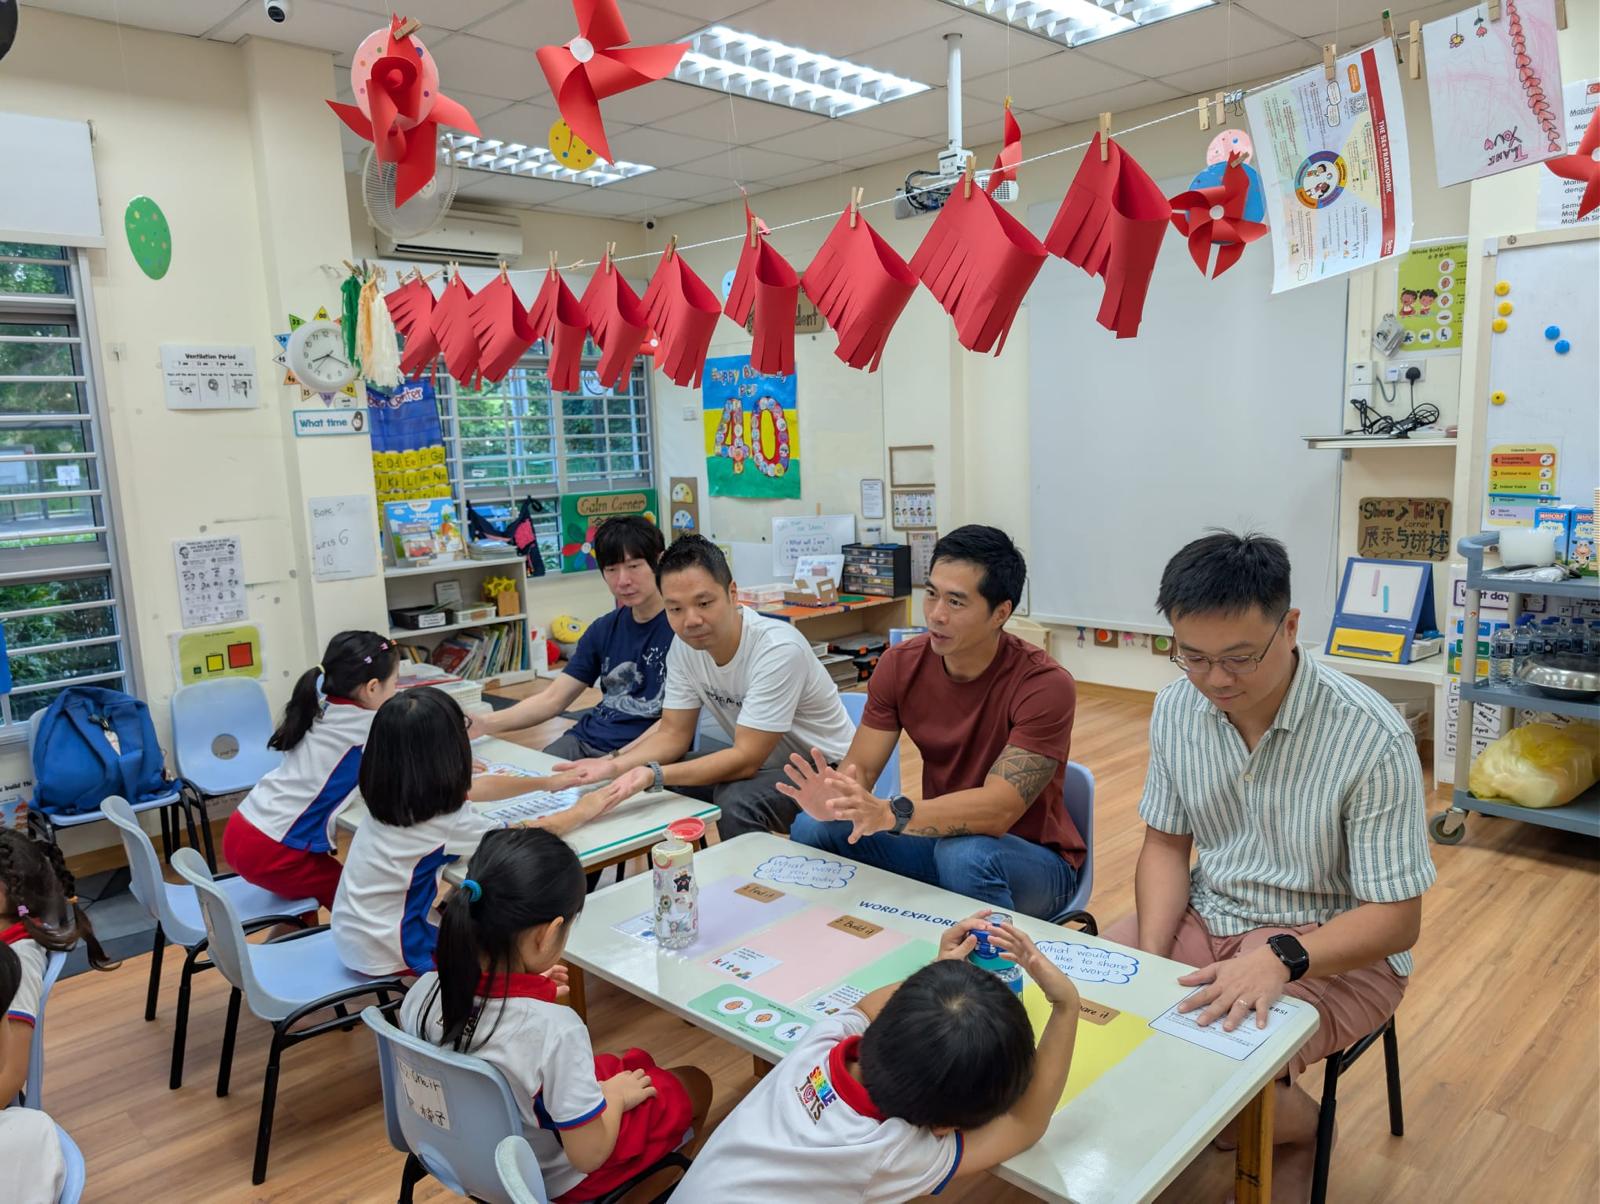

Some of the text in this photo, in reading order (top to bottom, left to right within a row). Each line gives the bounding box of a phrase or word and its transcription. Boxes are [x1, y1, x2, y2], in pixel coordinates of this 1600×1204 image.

[300, 418, 348, 428] What time
[715, 396, 790, 478] 40
[580, 496, 646, 514] Calm Corner
[1364, 502, 1395, 520] Show
[1404, 520, 1430, 529] Corner
[338, 528, 349, 546] 6
[1476, 740, 1488, 748] May
[860, 900, 899, 914] WORD
[1040, 944, 1112, 960] What would
[1055, 954, 1073, 962] like
[1098, 961, 1128, 970] share
